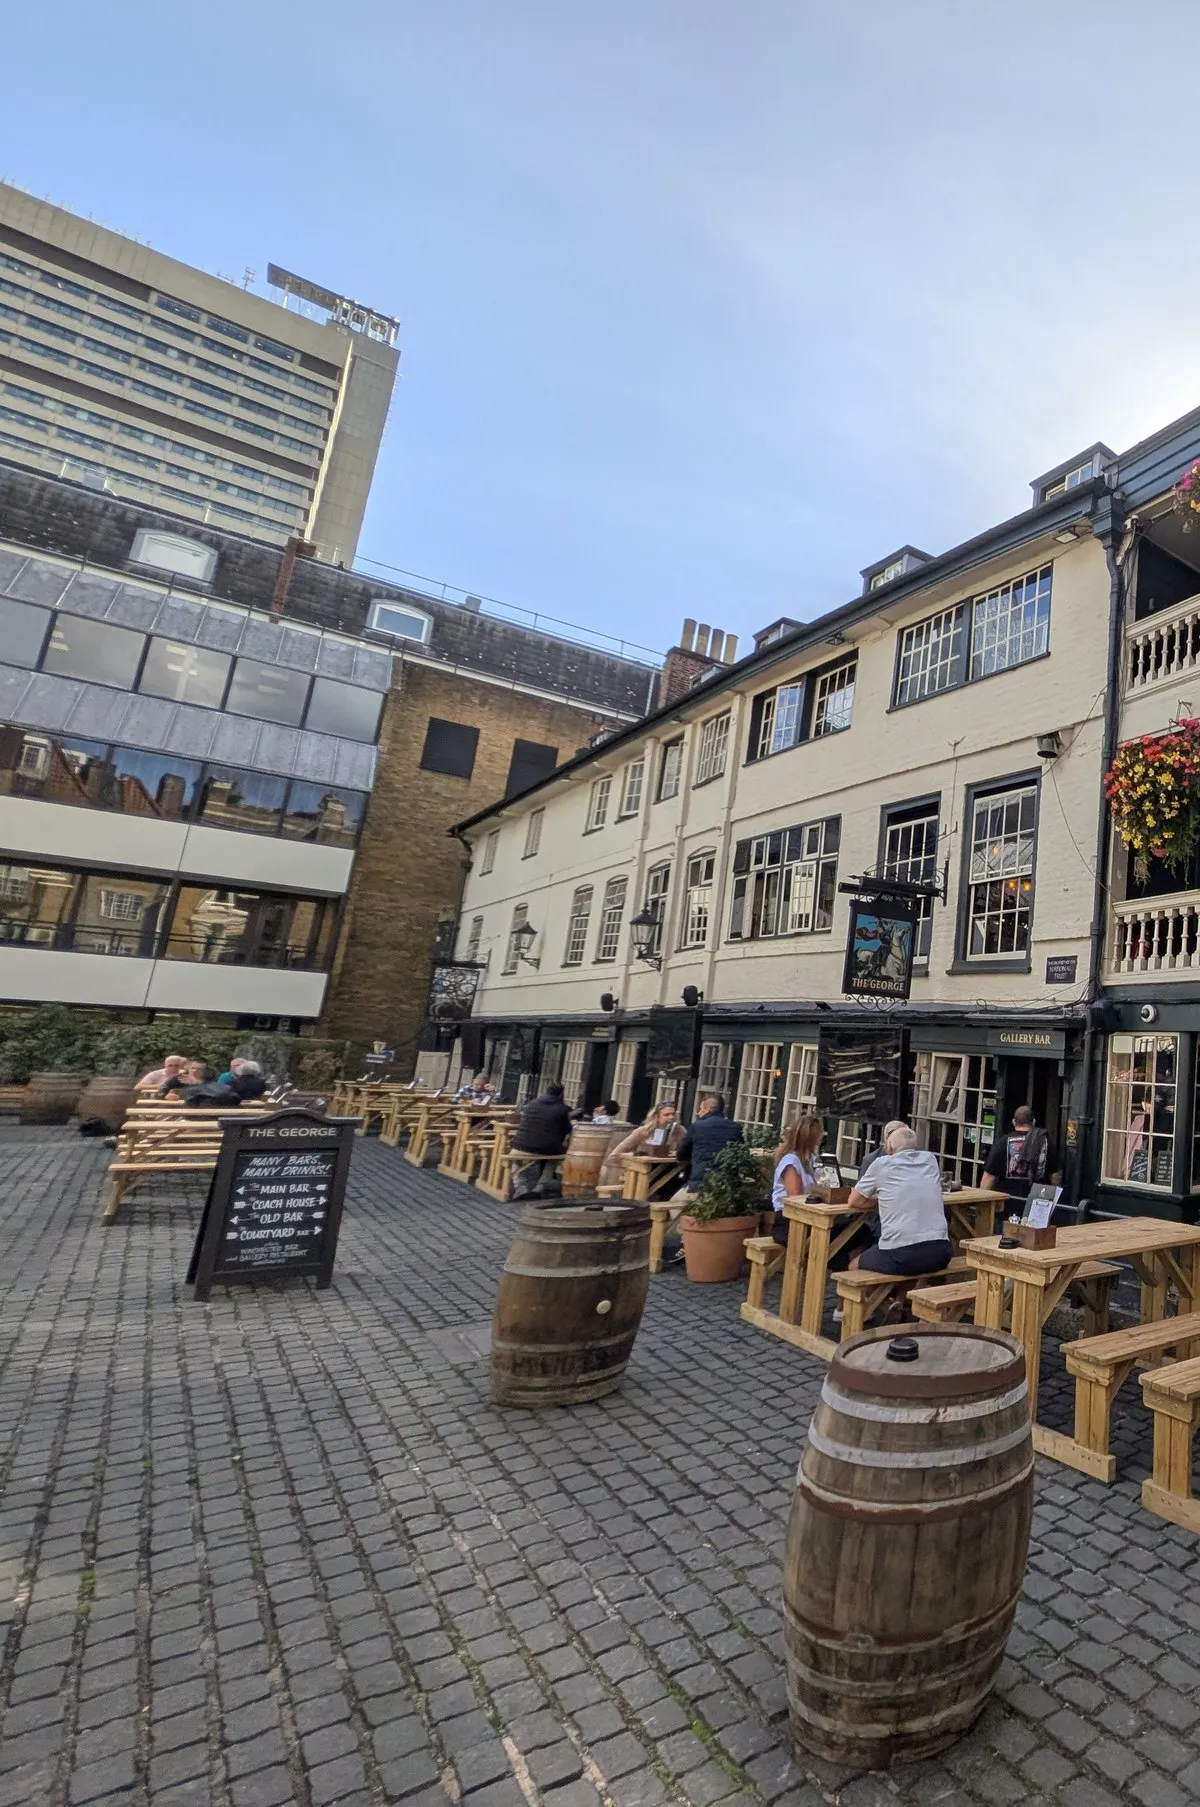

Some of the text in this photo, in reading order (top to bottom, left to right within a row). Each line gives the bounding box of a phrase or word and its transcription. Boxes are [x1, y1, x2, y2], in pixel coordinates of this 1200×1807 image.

[852, 978, 905, 992] THE GEORGE
[1000, 1032, 1052, 1045] GALLERY BAR
[248, 1127, 338, 1138] THE GEORGE
[249, 1157, 284, 1167] MANY
[242, 1164, 333, 1178] MANY DRINKS!
[260, 1184, 287, 1195] MAIN
[289, 1183, 310, 1194] BAR
[252, 1199, 284, 1211] COACH
[285, 1197, 317, 1209] HOUSE
[260, 1213, 281, 1225] OLD
[283, 1211, 304, 1223] BAR
[240, 1228, 295, 1241] COURTYARD
